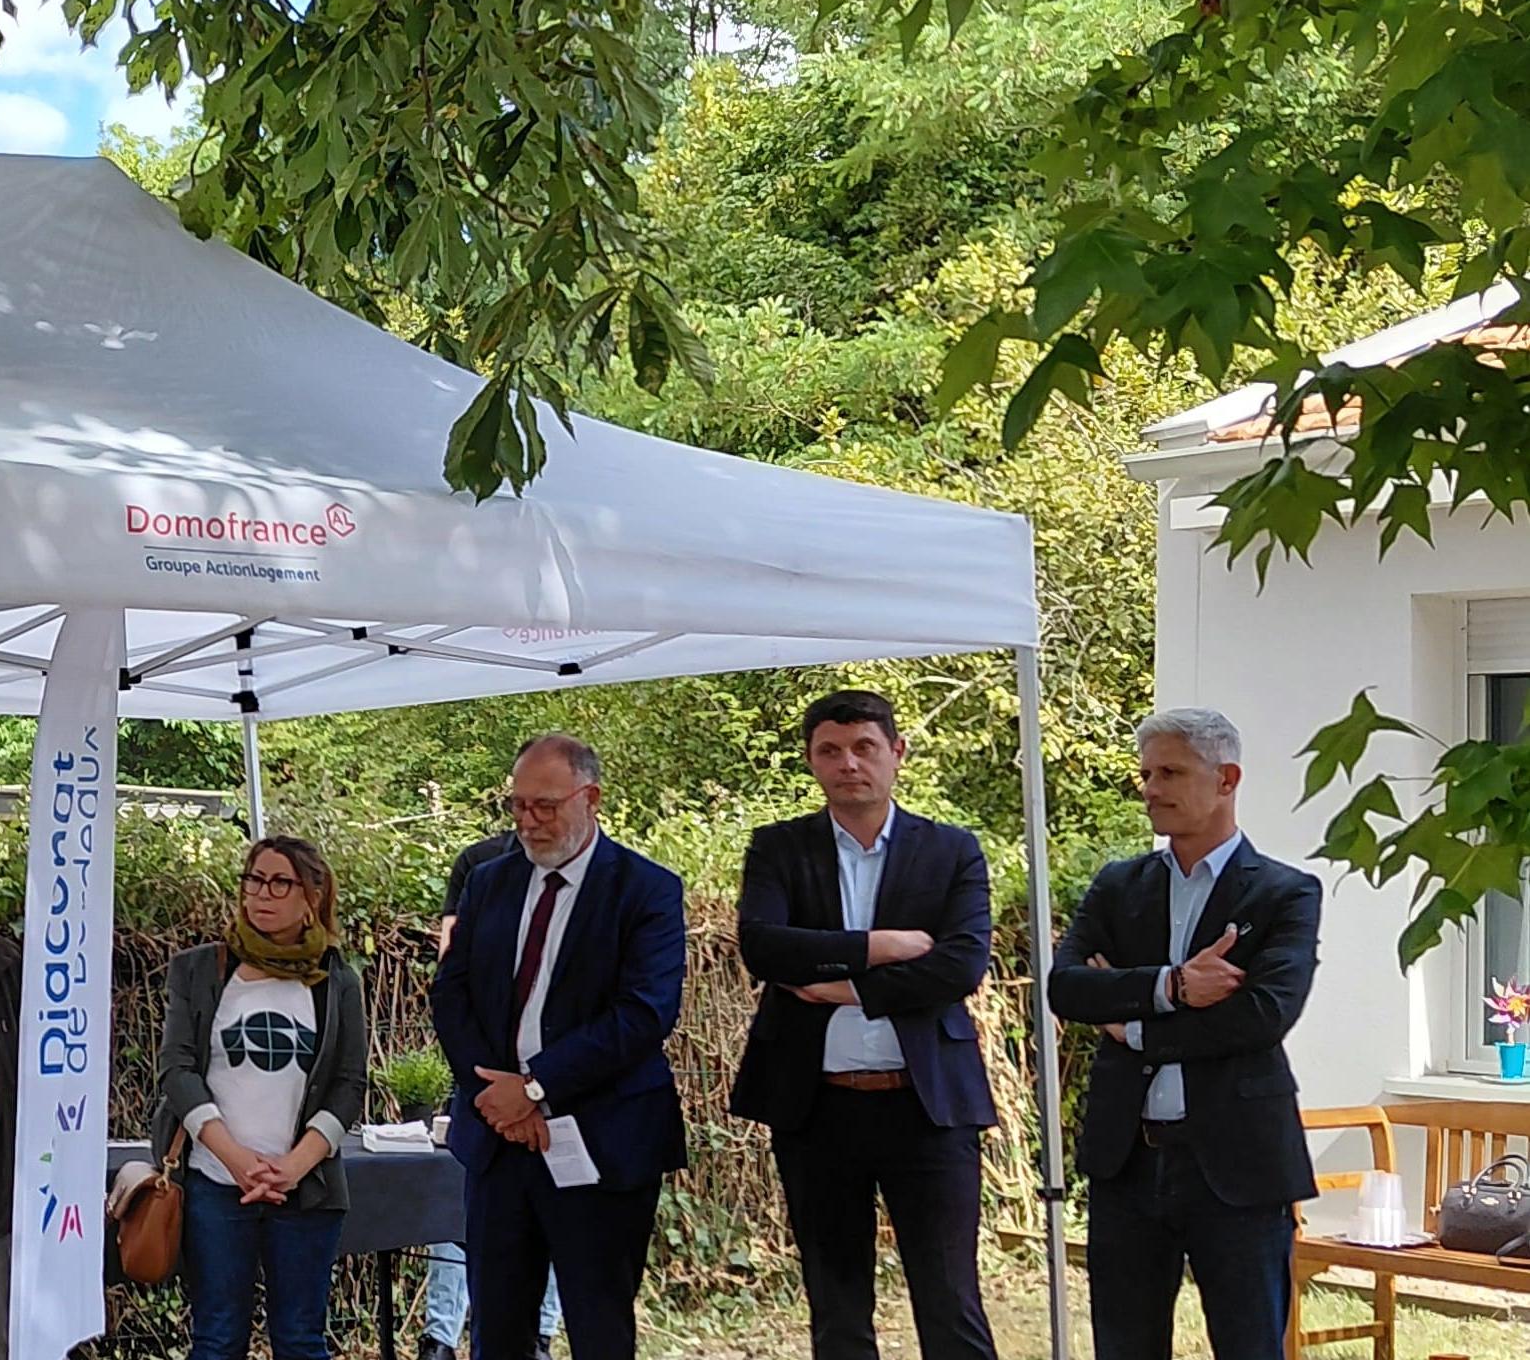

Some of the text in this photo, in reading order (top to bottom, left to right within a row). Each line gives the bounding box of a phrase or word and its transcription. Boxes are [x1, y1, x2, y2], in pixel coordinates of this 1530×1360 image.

[126, 504, 327, 546] Domofrance
[145, 555, 321, 583] Groupe ActionLogement
[39, 750, 75, 1075] Diaconat
[65, 725, 100, 1074] de Bdeaux
